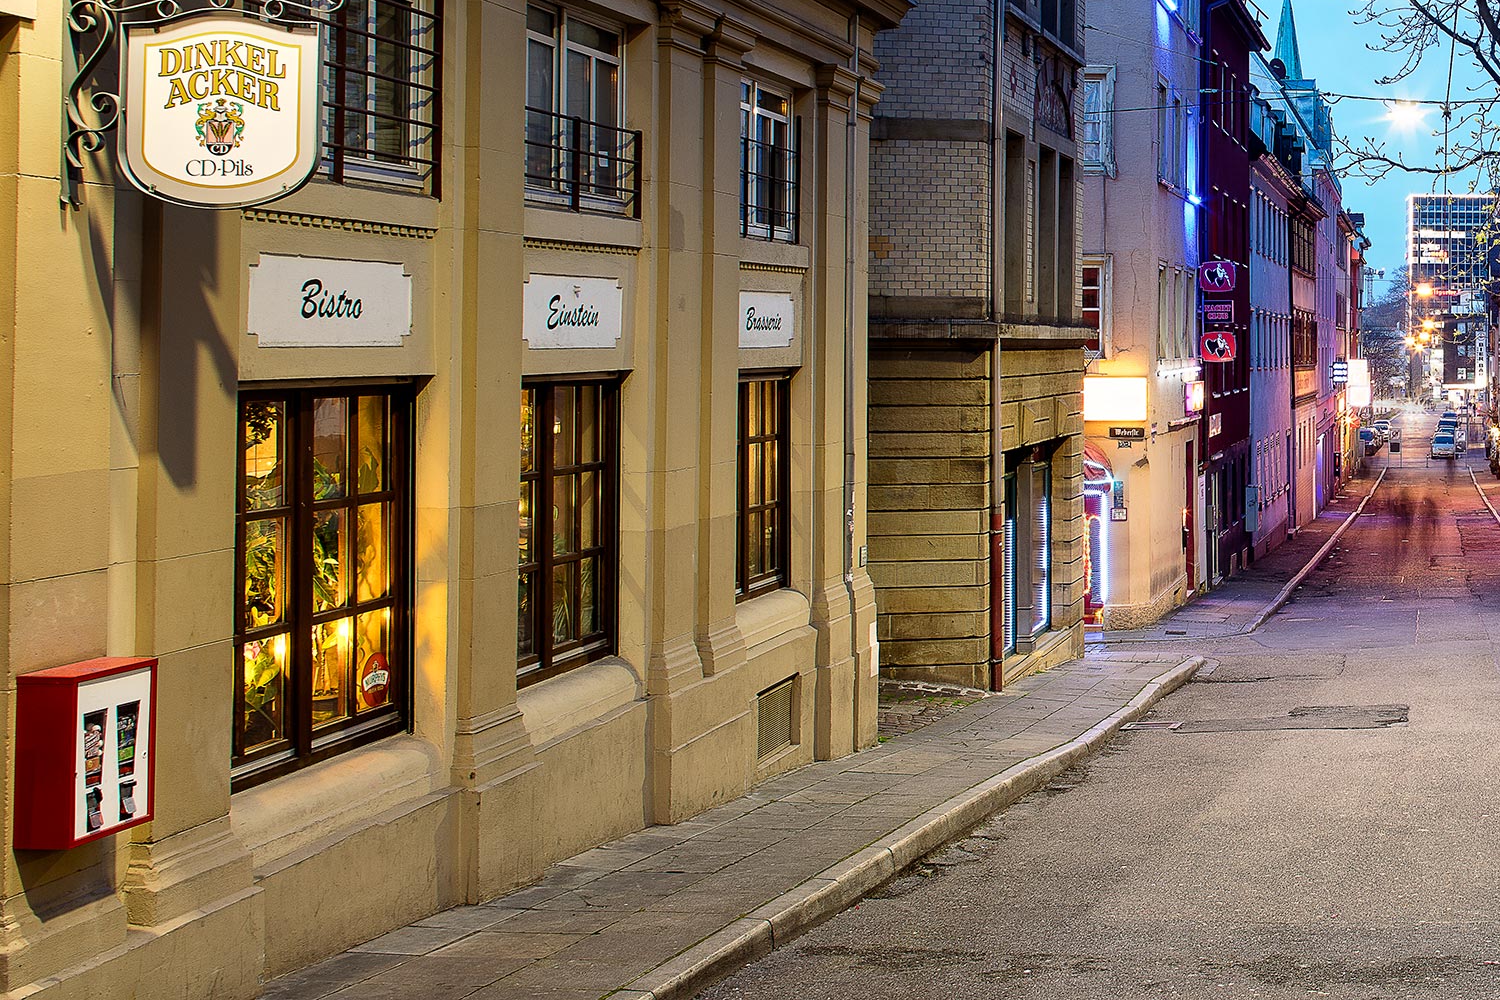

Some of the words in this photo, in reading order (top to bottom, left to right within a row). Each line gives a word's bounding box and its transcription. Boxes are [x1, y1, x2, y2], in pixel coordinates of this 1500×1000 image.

[158, 40, 287, 79] DINKEL
[164, 68, 281, 111] ACKER
[210, 144, 230, 154] CD
[185, 159, 254, 177] CD-Pils
[301, 278, 363, 319] Bistro
[1204, 304, 1231, 312] NACHT
[546, 294, 600, 330] Einstein
[746, 306, 782, 331] Brasserie
[1207, 312, 1229, 320] CLUB
